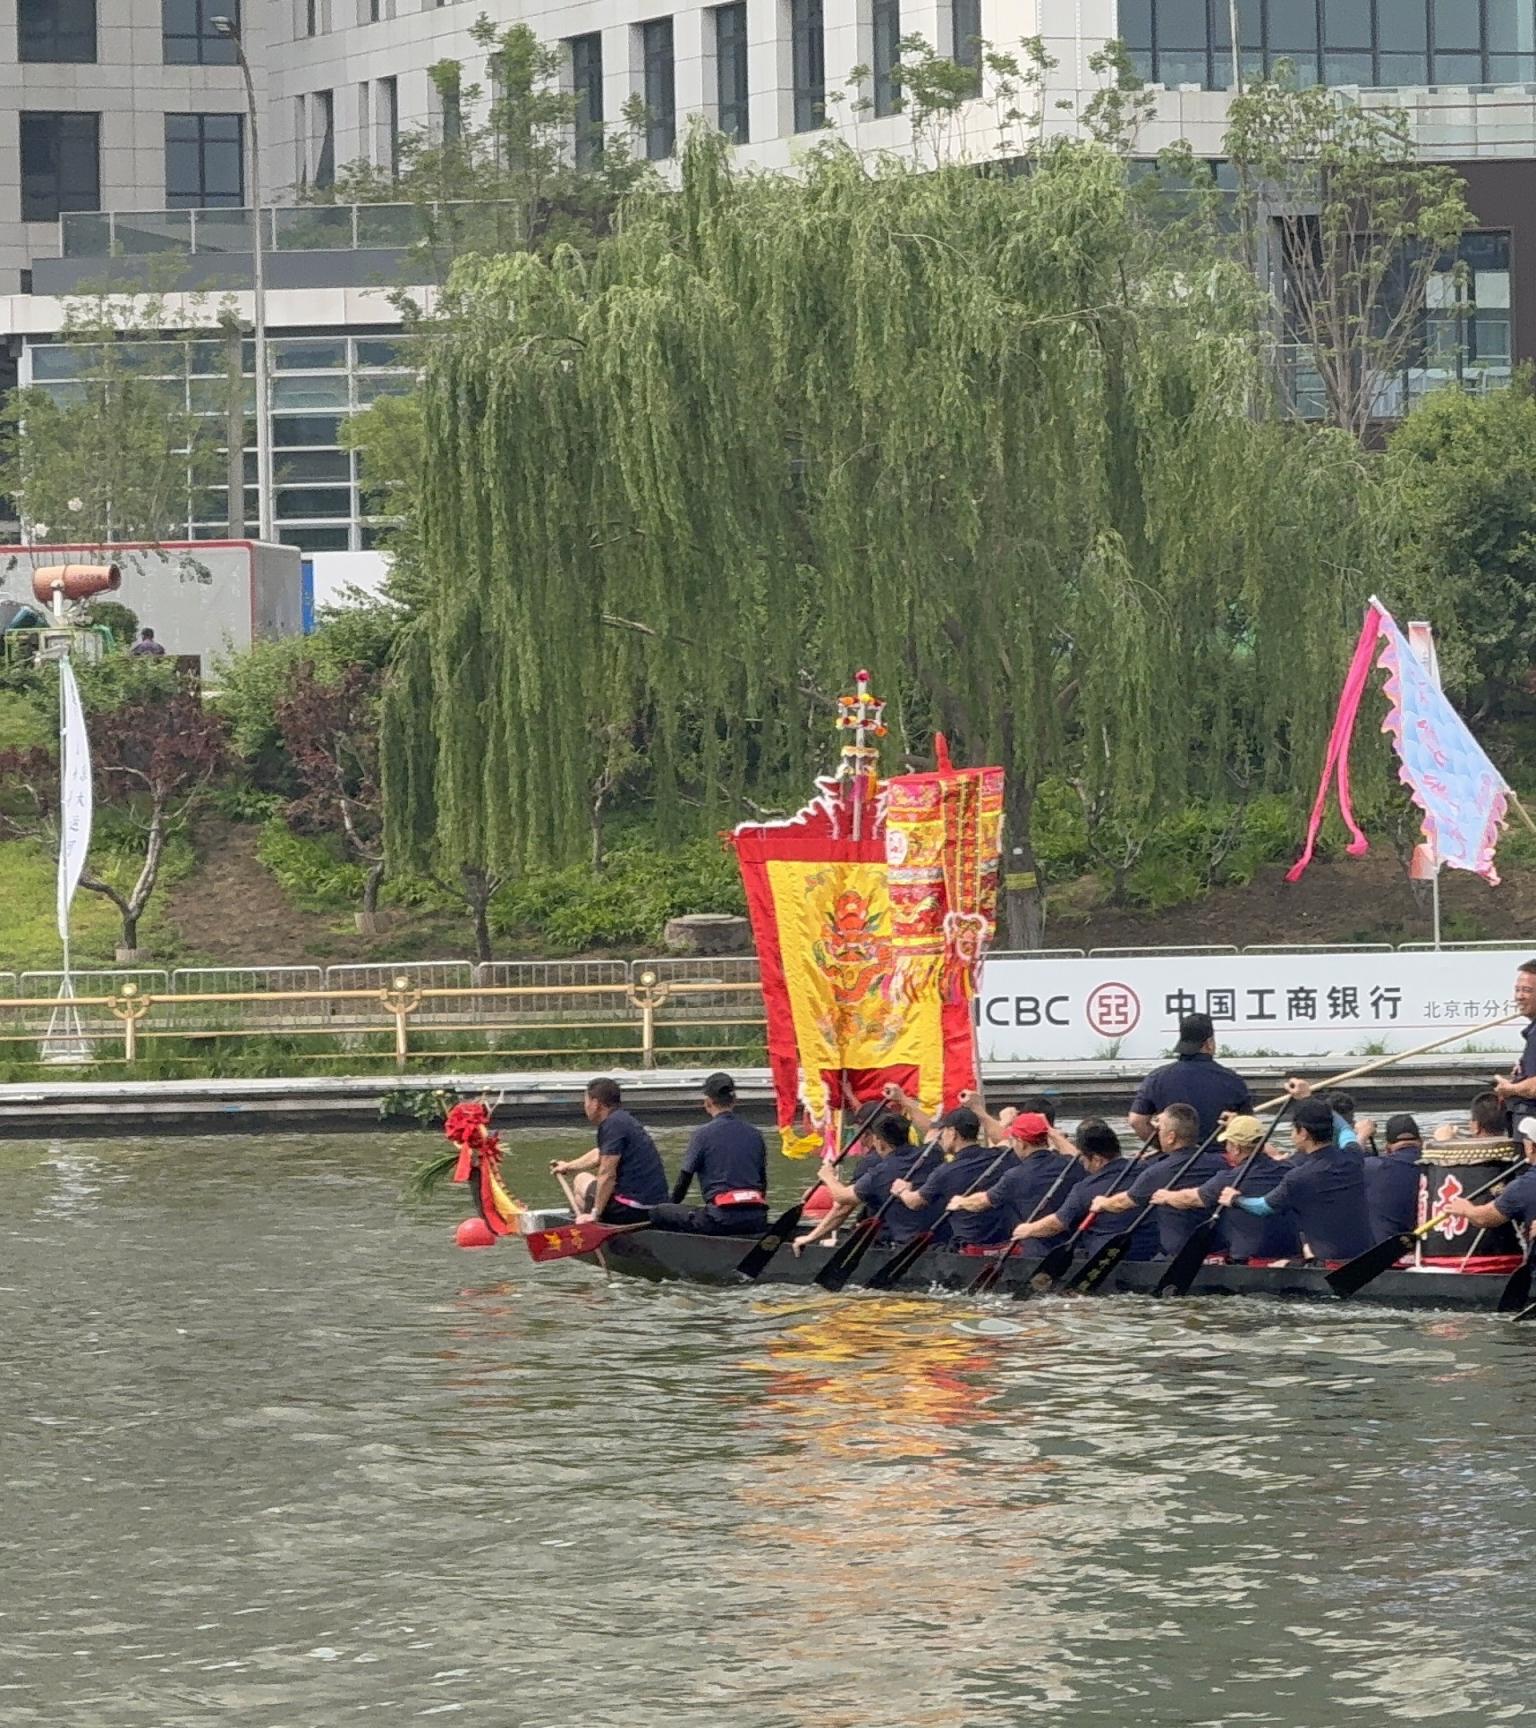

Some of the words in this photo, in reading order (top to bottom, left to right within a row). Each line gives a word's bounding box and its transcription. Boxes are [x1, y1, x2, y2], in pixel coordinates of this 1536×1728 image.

[974, 995, 1070, 1027] ICBC
[1165, 985, 1402, 1023] 中国工商银行
[1423, 998, 1519, 1019] 北京市分行
